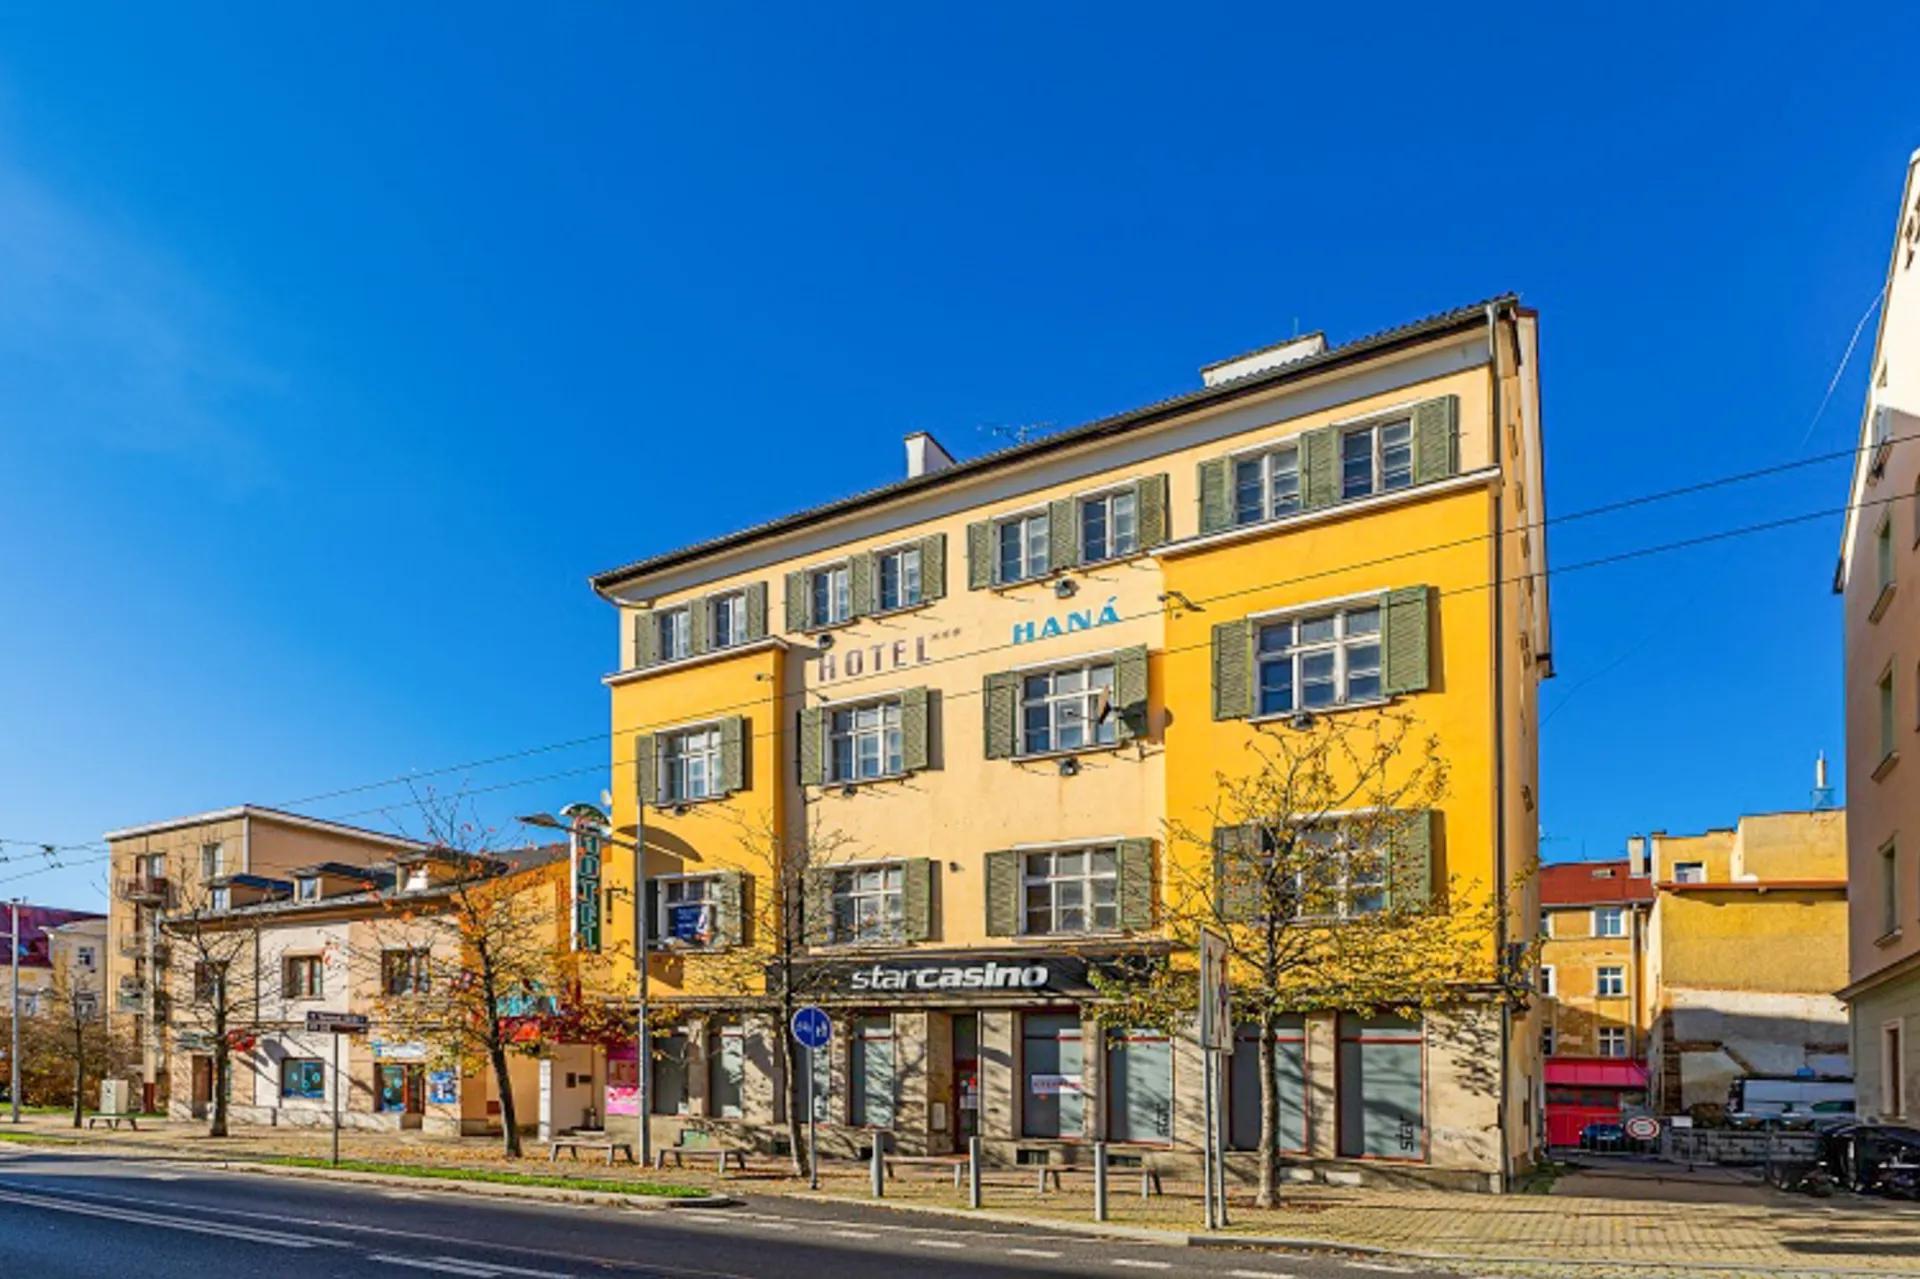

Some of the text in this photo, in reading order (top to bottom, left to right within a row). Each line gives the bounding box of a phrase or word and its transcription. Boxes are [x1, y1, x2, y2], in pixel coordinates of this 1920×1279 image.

[1013, 597, 1120, 645] HANÁ
[819, 637, 931, 682] HOTEL
[851, 962, 1048, 989] starcasino
